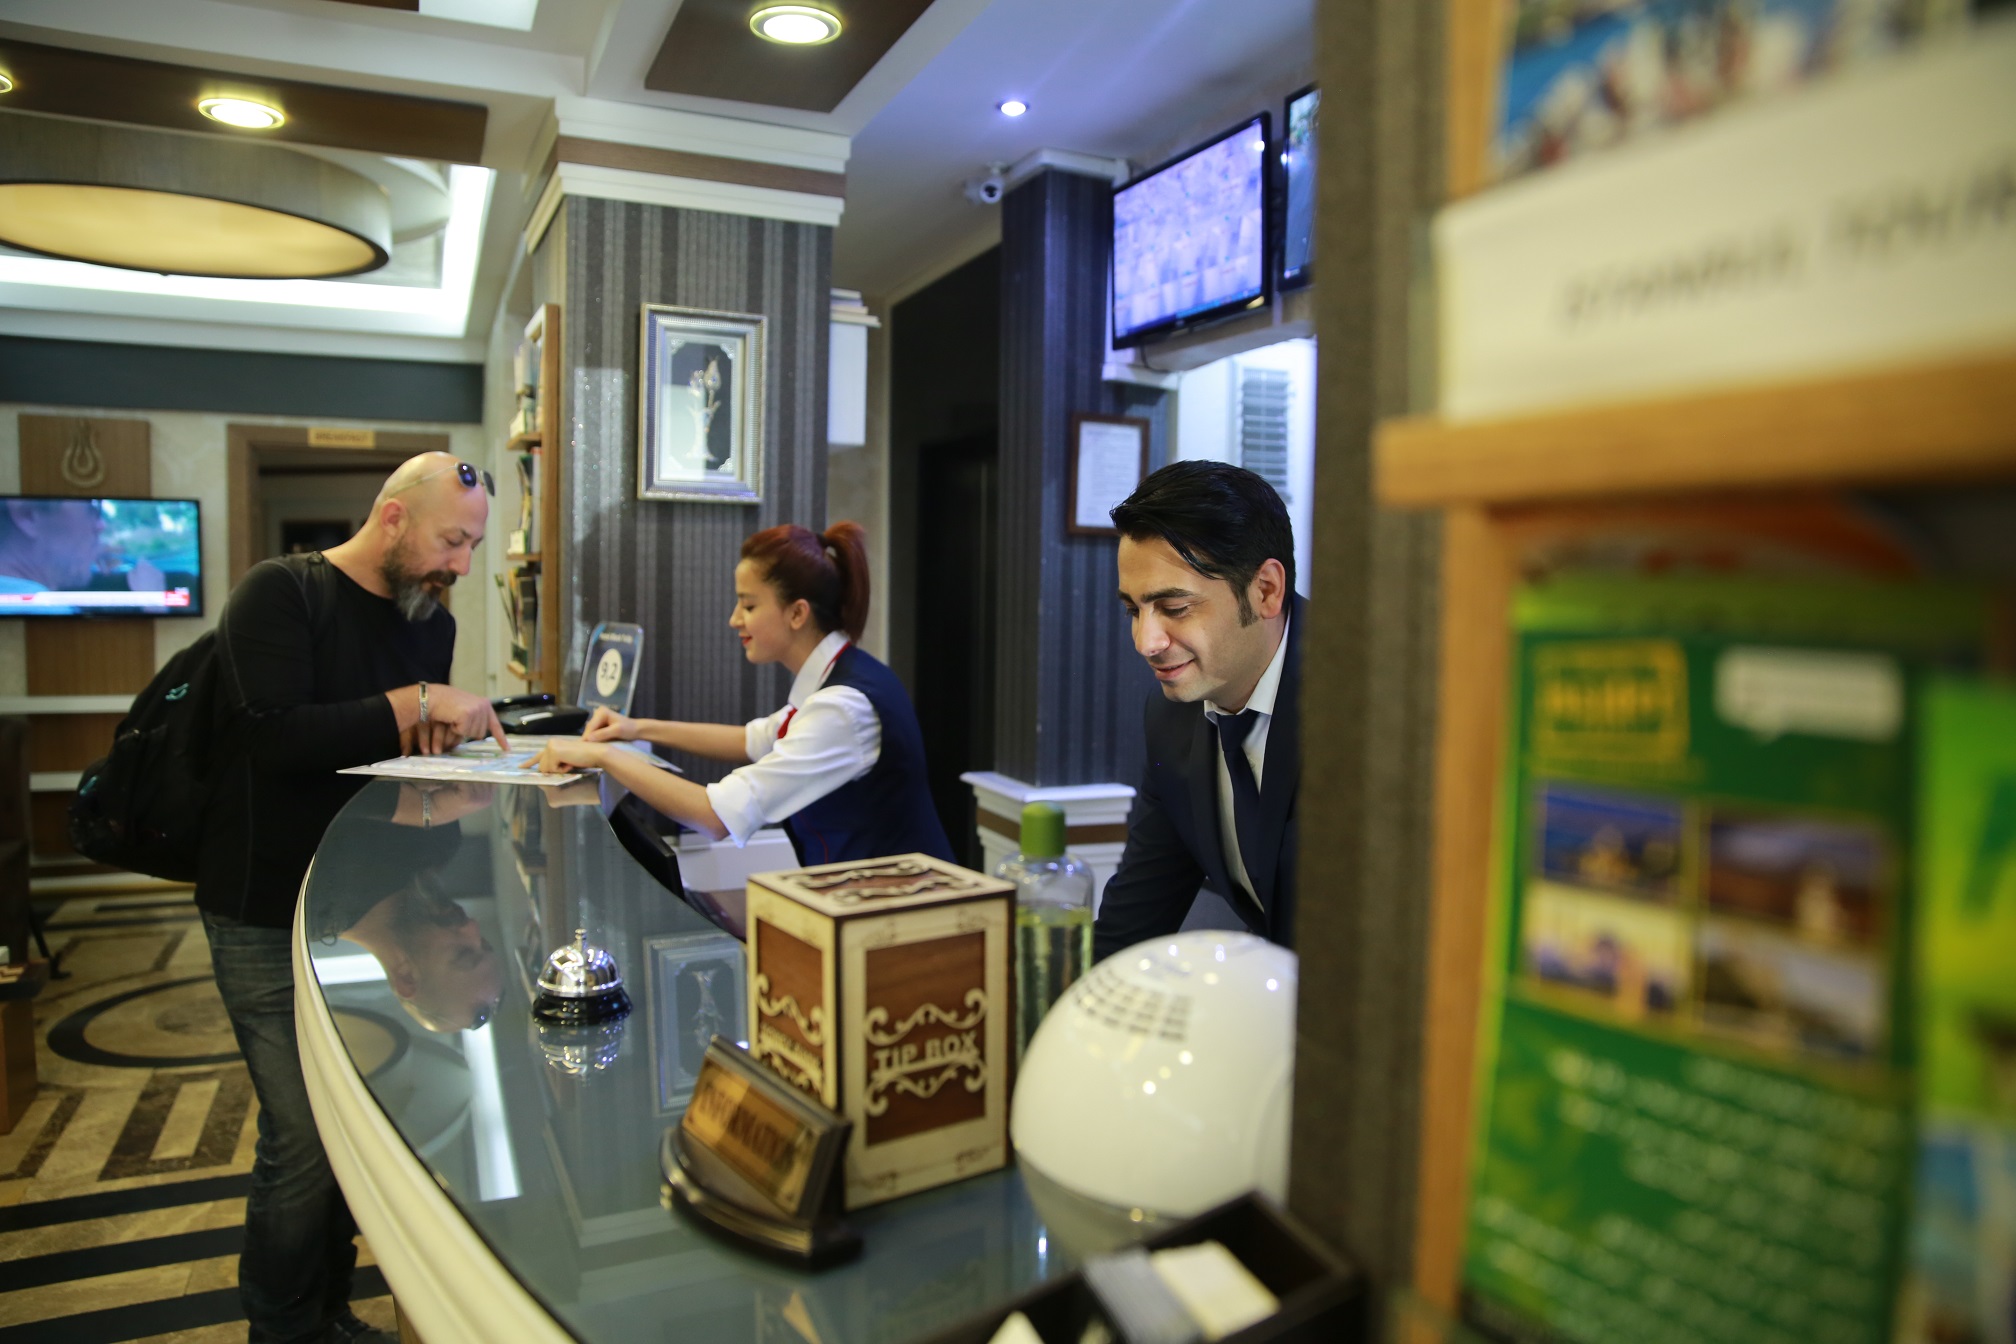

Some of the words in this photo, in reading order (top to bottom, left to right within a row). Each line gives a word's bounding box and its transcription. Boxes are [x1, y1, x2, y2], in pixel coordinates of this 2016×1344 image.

[600, 661, 618, 681] 9,2
[873, 1043, 918, 1071] TIP
[925, 1031, 979, 1062] BOX
